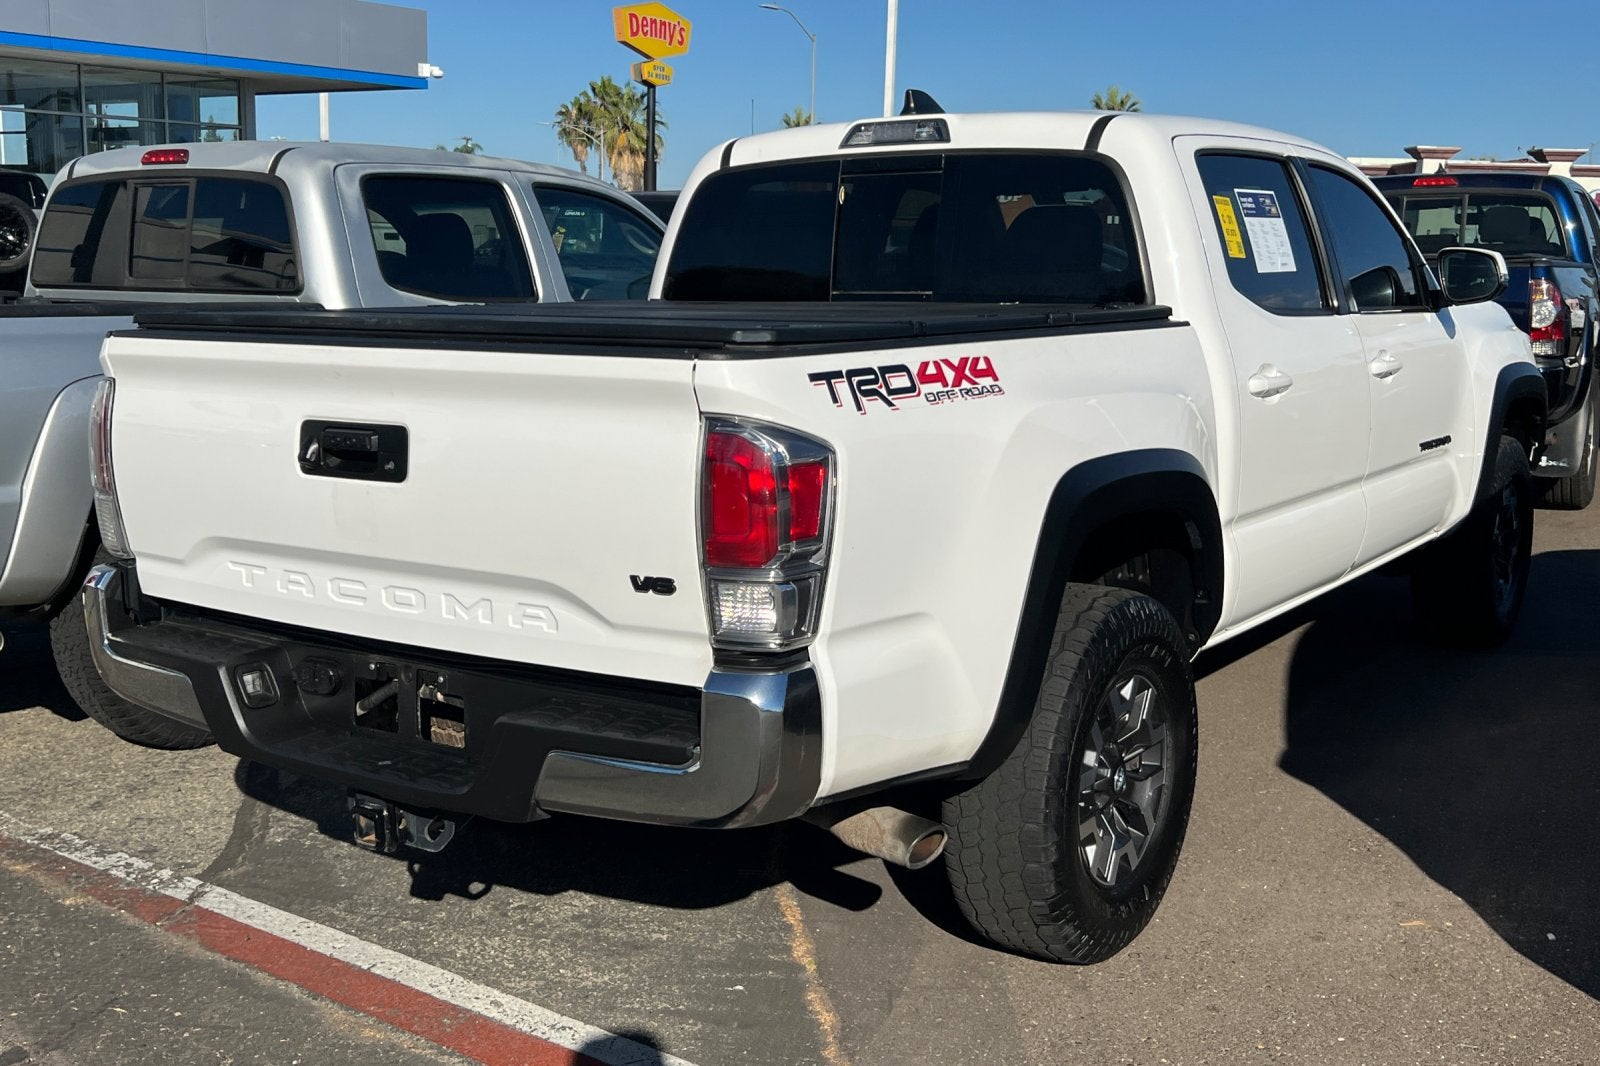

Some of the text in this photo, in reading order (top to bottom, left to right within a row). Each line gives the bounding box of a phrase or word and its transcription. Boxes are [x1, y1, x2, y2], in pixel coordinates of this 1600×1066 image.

[628, 12, 686, 47] Denny's
[807, 363, 920, 415] TRD
[924, 384, 1004, 405] OFF ROAD
[227, 560, 559, 633] TACOMA
[629, 574, 677, 596] V6
